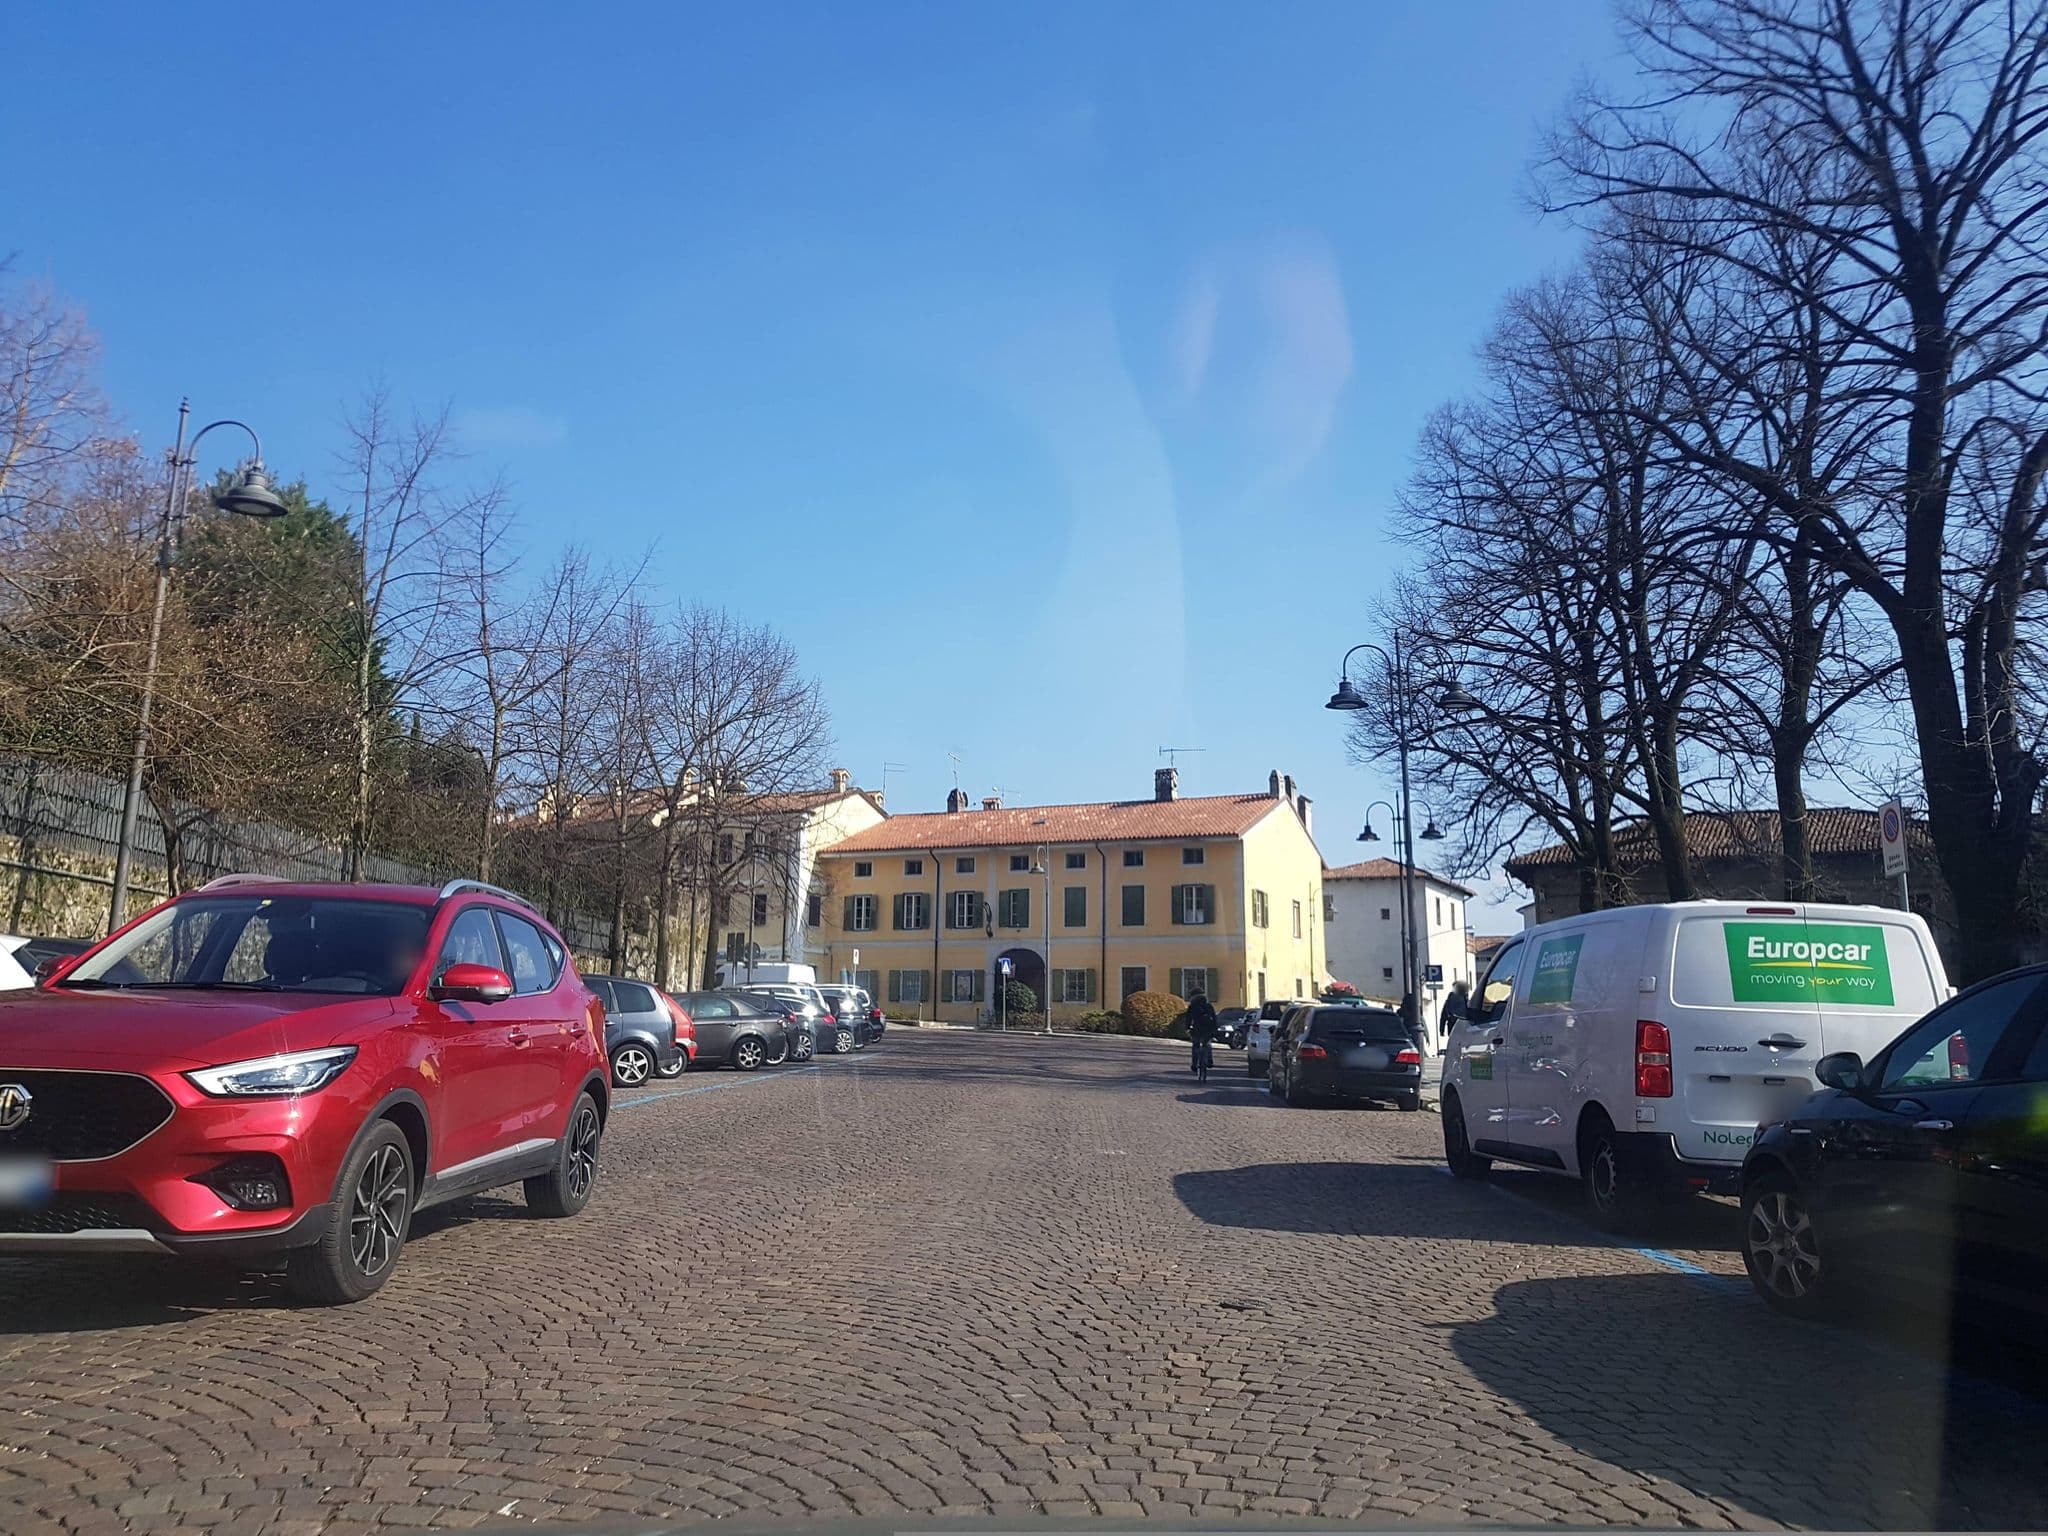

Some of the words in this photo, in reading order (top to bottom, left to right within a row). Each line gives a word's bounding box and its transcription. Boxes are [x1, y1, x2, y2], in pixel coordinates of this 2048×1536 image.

[1540, 950, 1576, 969] Europcar
[1748, 936, 1872, 968] Europcar
[1429, 967, 1438, 980] P
[1751, 974, 1805, 989] moving
[1807, 976, 1844, 988] your
